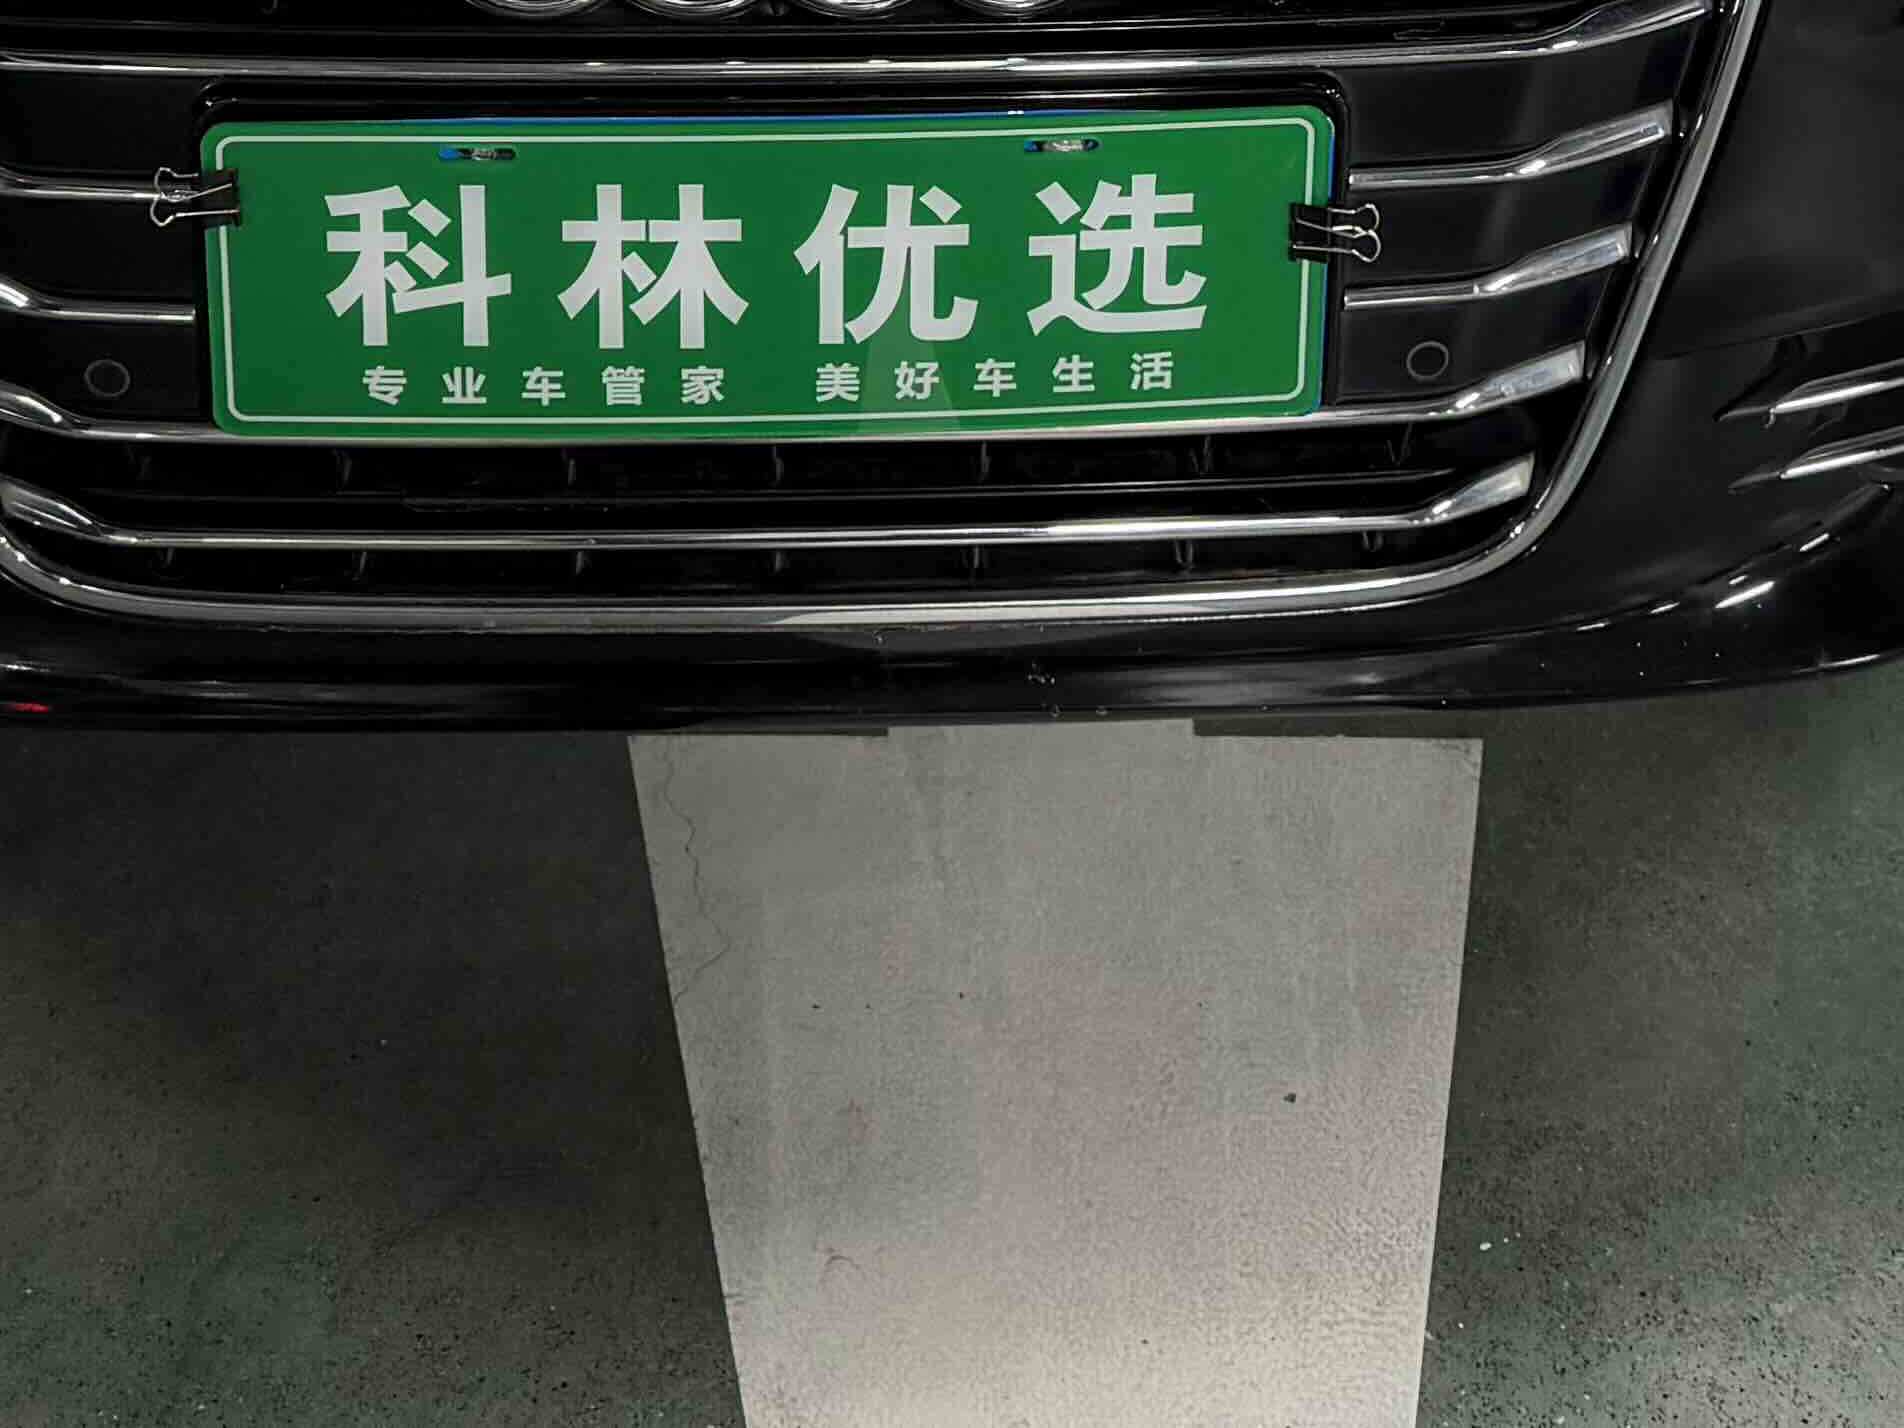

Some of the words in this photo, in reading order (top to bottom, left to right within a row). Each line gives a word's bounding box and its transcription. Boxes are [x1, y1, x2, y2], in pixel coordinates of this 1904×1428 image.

[325, 173, 1208, 350] 科林优选
[361, 363, 726, 408] 专业车管家
[815, 350, 1176, 402] 美好车生活
